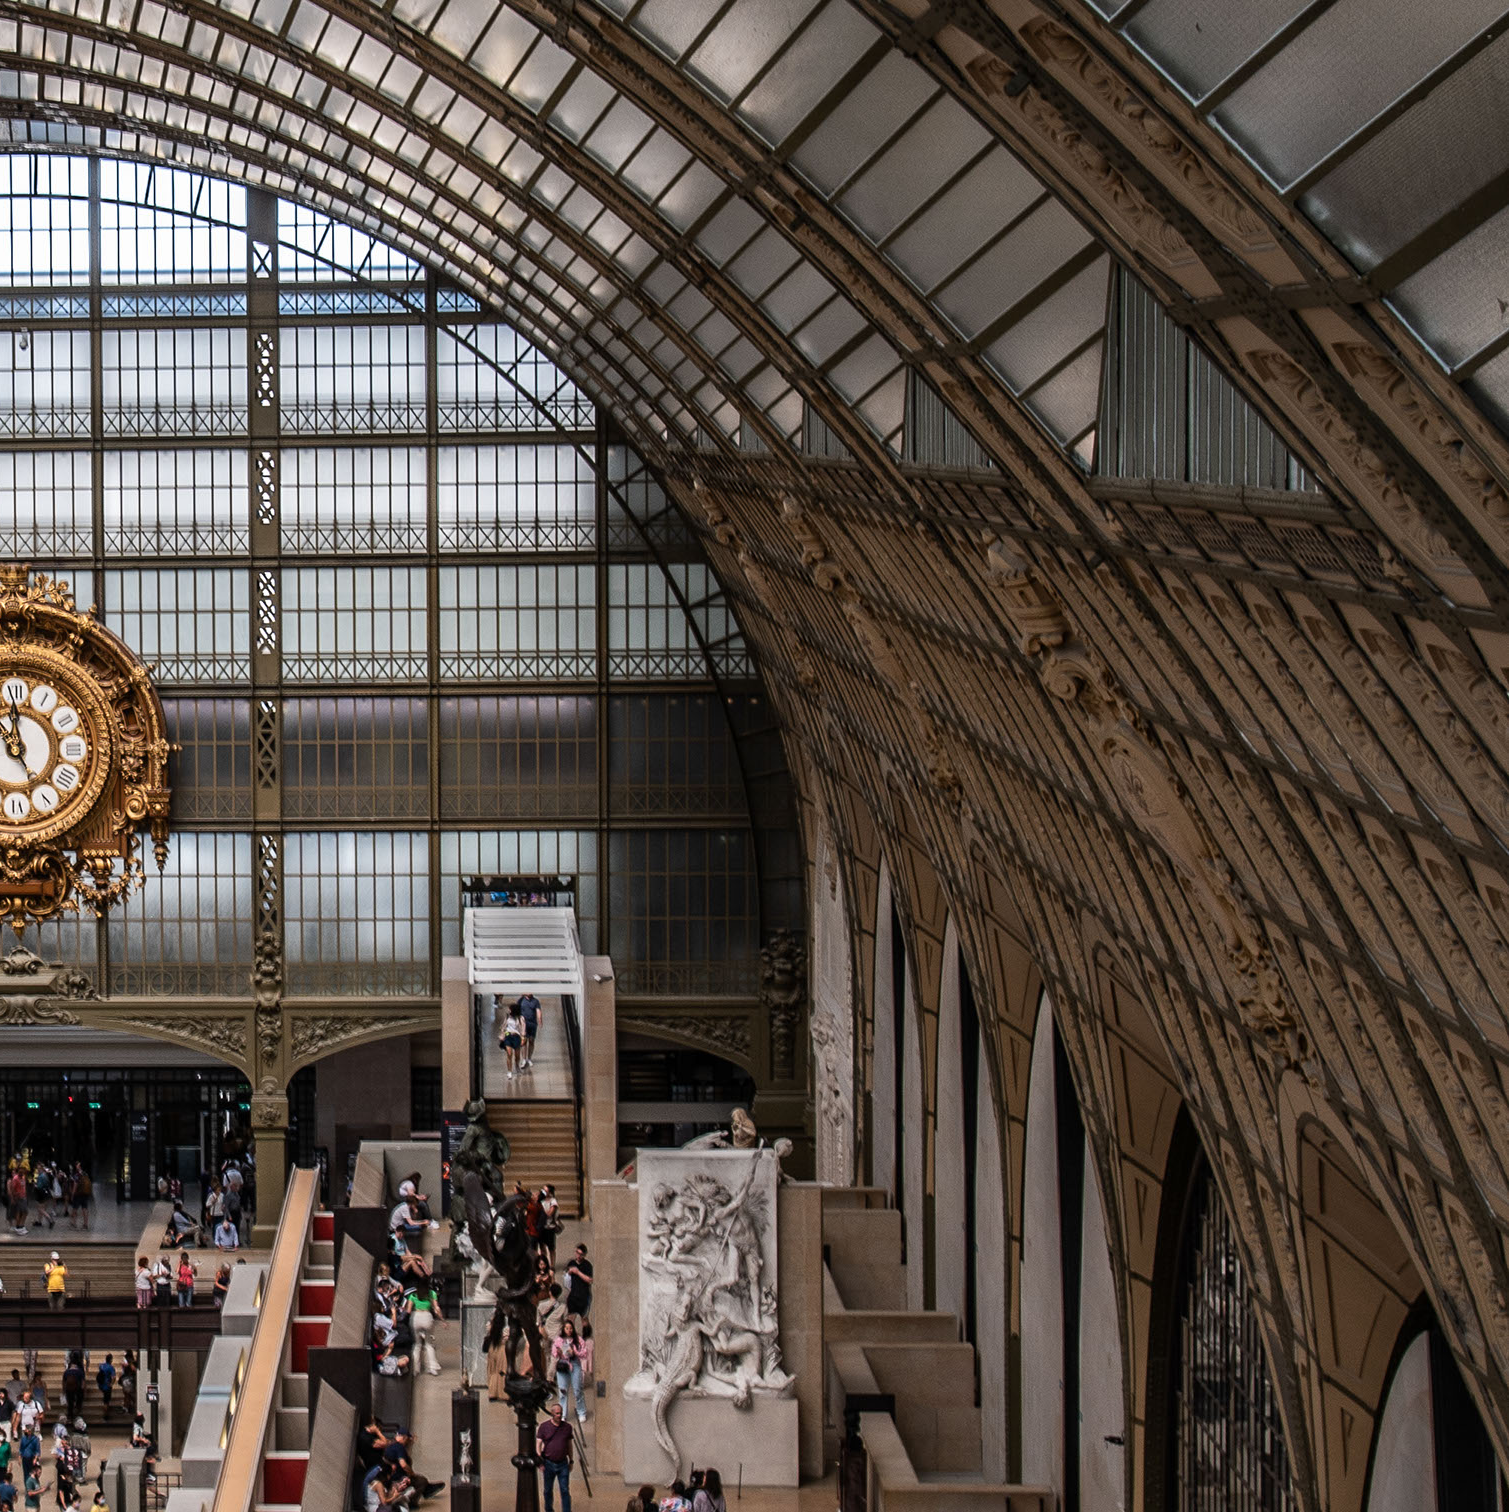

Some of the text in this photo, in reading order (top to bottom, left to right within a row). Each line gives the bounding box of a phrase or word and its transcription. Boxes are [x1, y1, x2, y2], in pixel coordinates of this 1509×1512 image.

[58, 713, 73, 728] II
[66, 743, 81, 756] III
[56, 767, 76, 789] IIII
